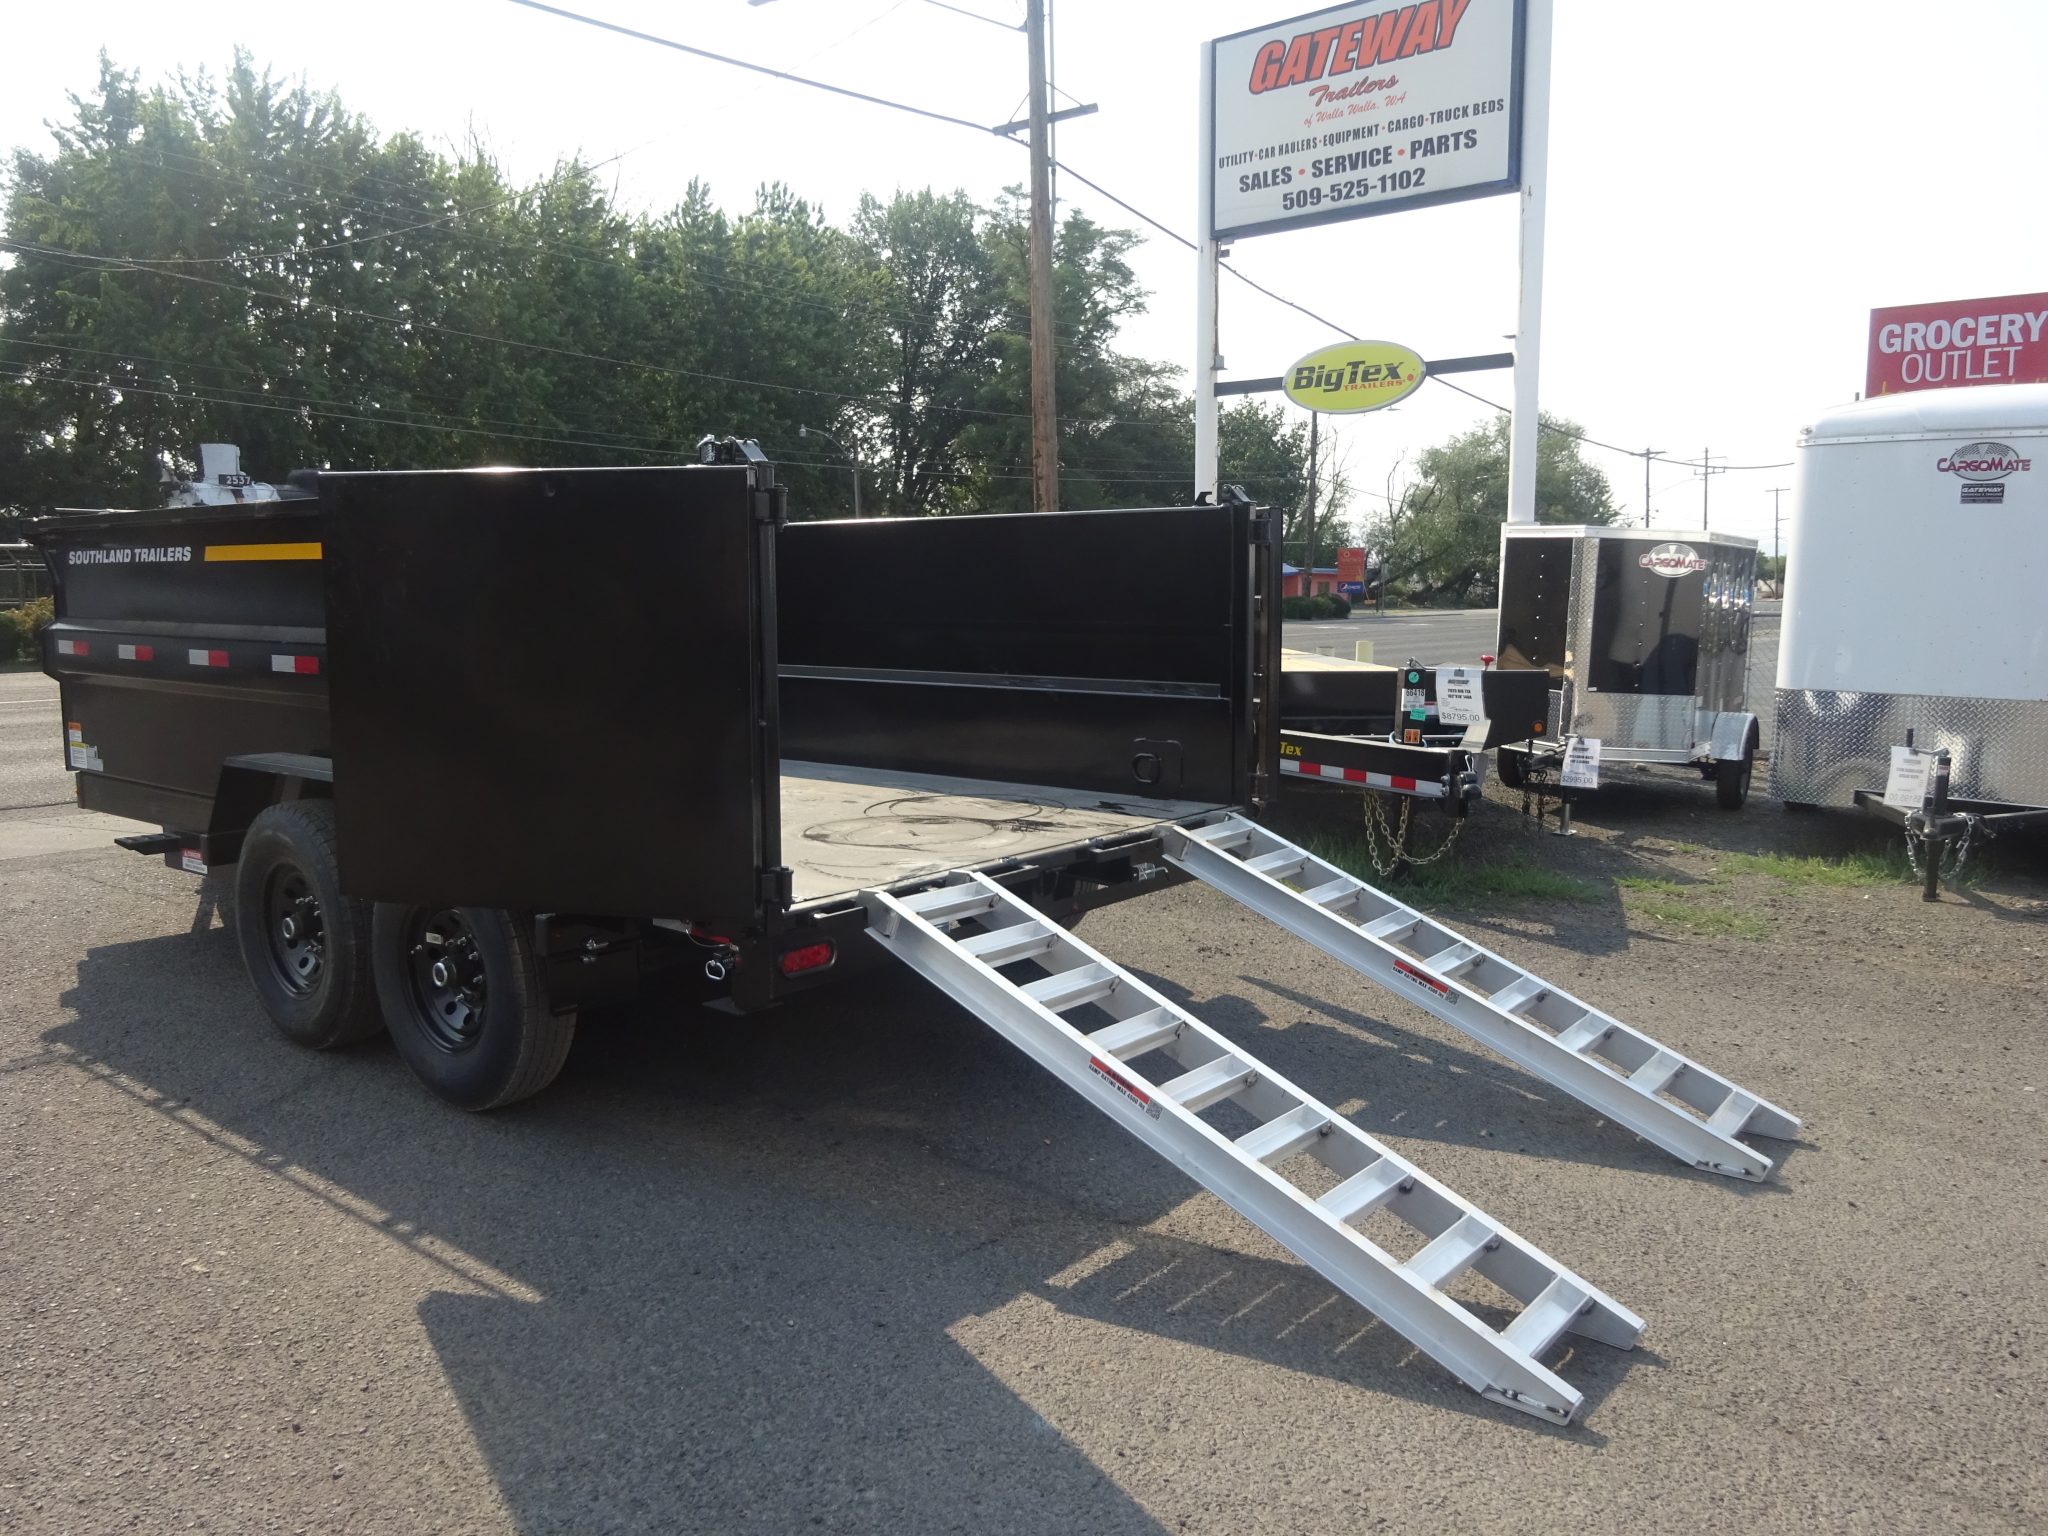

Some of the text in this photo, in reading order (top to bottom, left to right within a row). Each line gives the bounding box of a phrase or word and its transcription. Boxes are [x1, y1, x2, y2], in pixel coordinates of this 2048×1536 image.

[1249, 0, 1471, 95] GATEWAY
[1304, 113, 1313, 128] of
[1316, 108, 1344, 122] Walla
[1384, 91, 1406, 107] WA
[1309, 75, 1400, 107] Trailers
[1219, 99, 1504, 168] UTILITY CAR HAULERS EQUIPMENT CARGO TRUCK BEDS
[1239, 129, 1478, 192] SALES SERVICE PARTS
[1282, 167, 1426, 211] 509-525-1102
[1878, 310, 2048, 354] GROCERY
[1901, 345, 2023, 383] OUTLET
[1343, 379, 1402, 392] TRAILERS
[226, 475, 250, 485] 2537
[68, 546, 192, 564] SOUTHLAND TRAILERS
[1441, 712, 1480, 722] $8795.00
[1280, 741, 1302, 756] Tex
